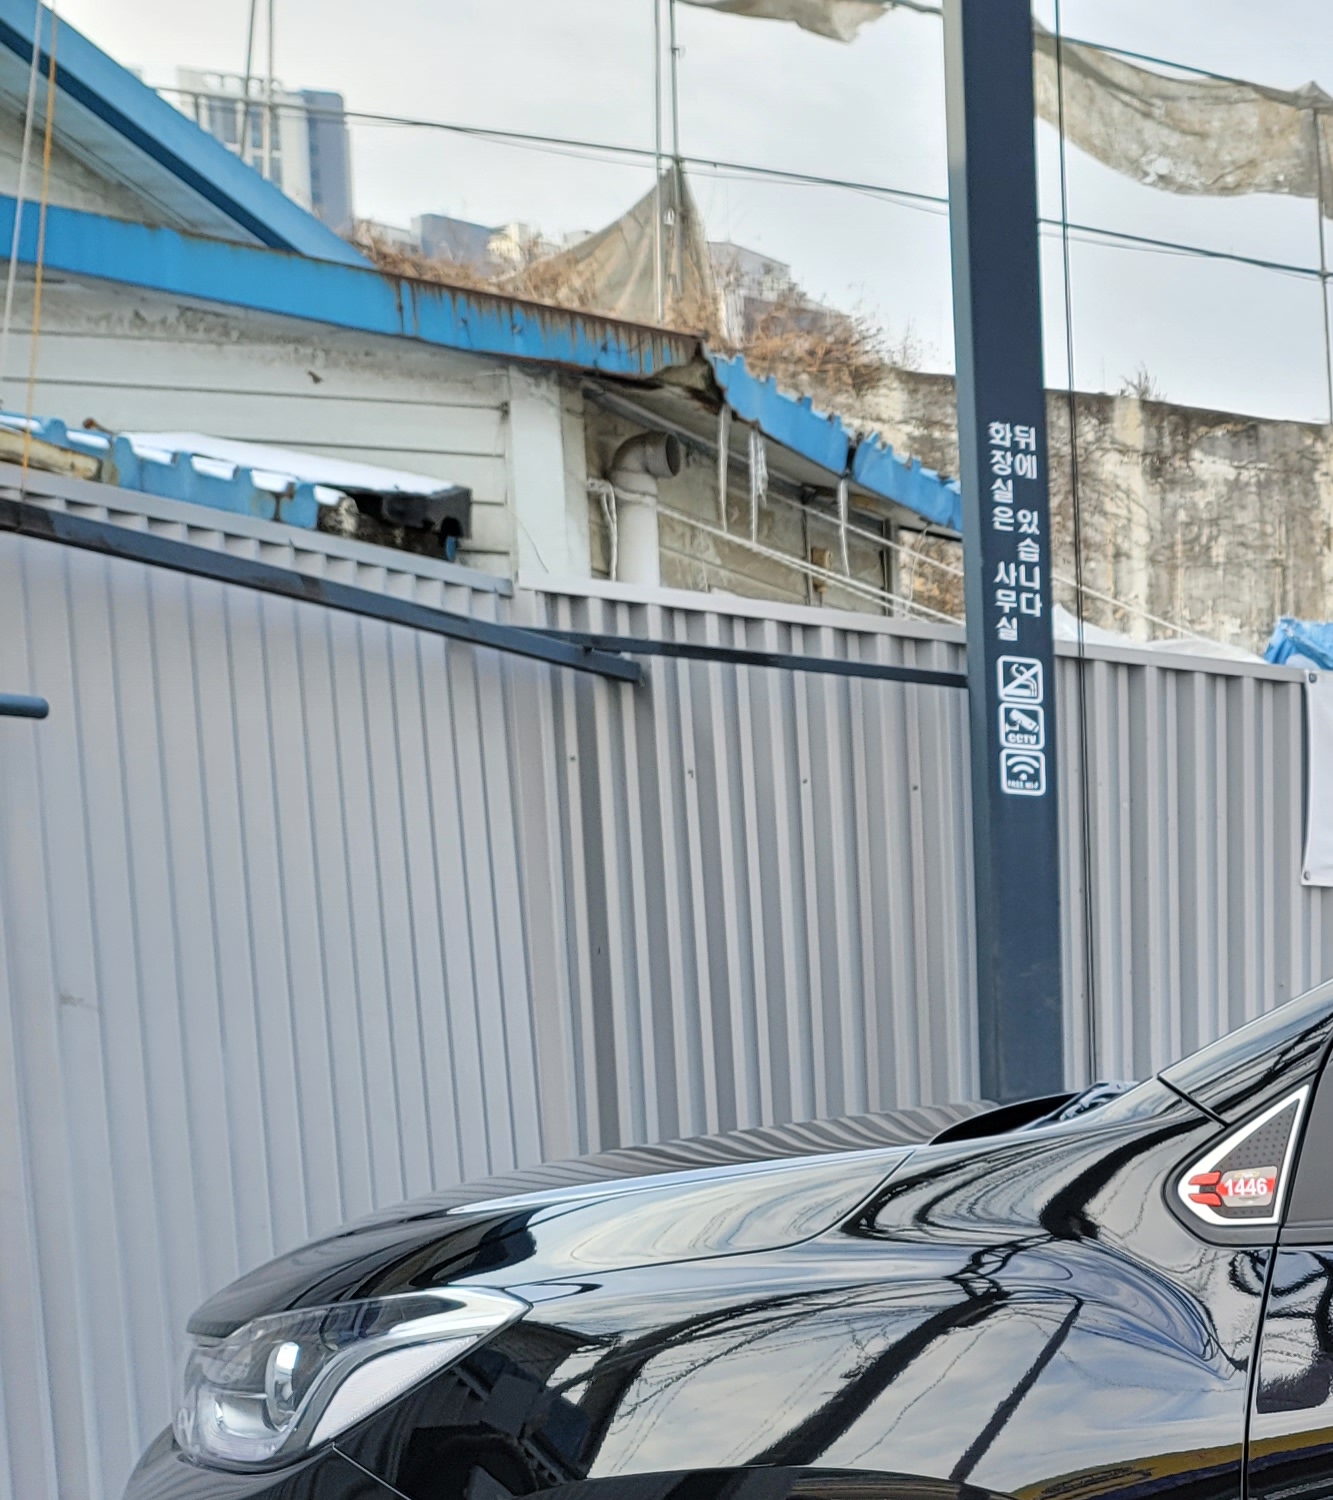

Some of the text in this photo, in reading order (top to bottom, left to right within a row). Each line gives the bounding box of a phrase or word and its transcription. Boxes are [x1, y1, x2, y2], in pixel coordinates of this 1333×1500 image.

[987, 420, 1019, 643] 화장실은 사무실
[1012, 424, 1043, 618] 뒤에 있습니다
[1007, 732, 1037, 745] CCTV
[1224, 1177, 1268, 1197] 1446
